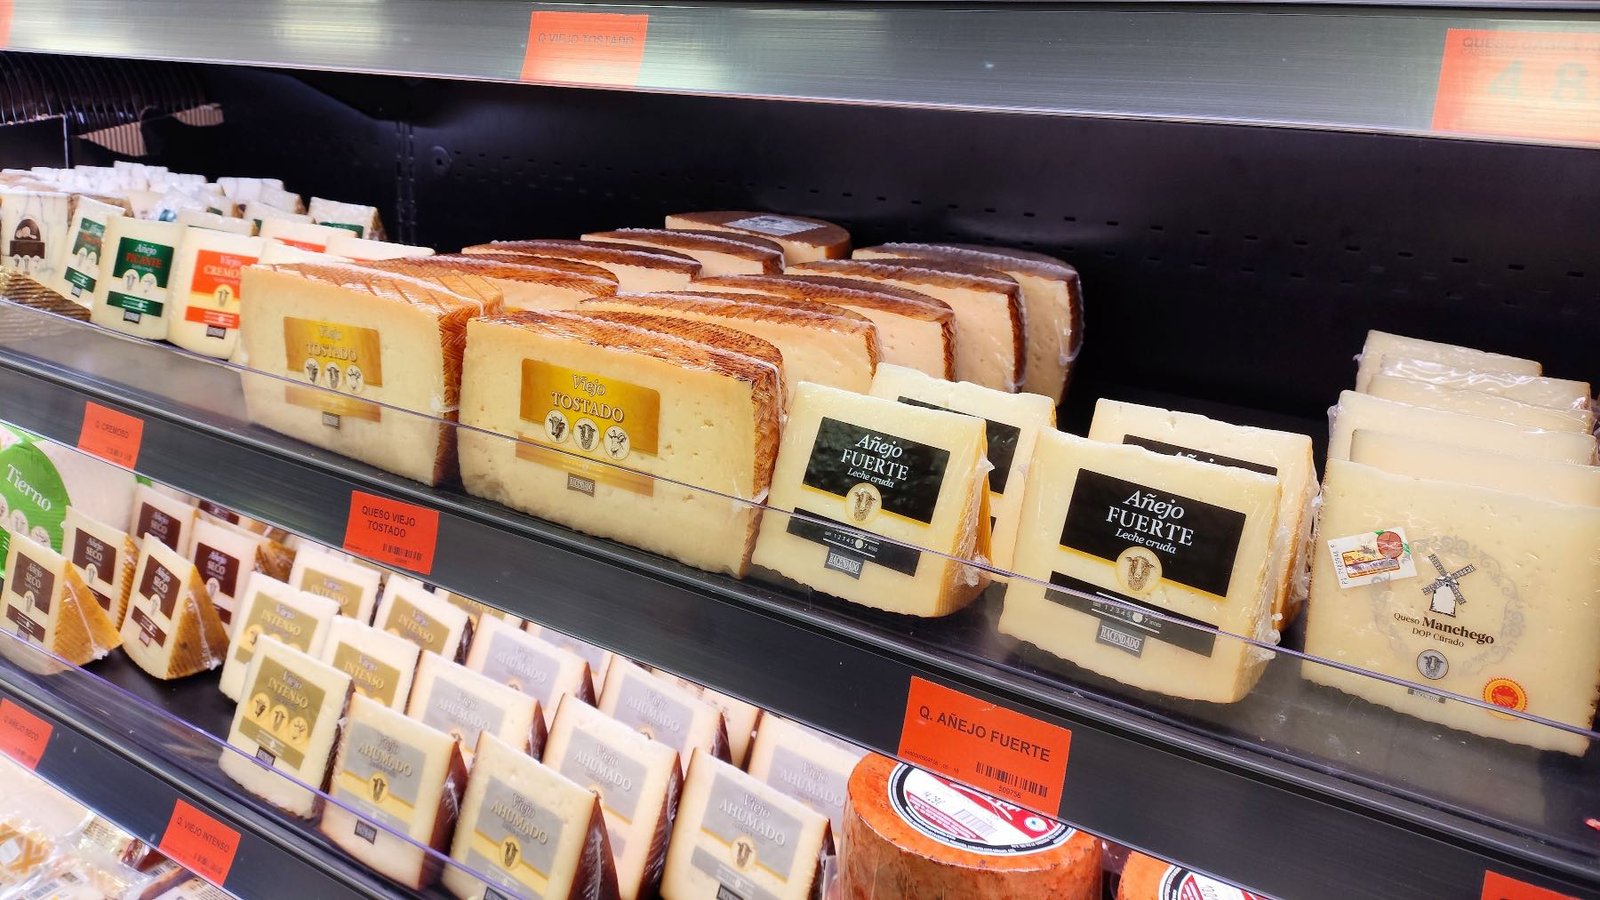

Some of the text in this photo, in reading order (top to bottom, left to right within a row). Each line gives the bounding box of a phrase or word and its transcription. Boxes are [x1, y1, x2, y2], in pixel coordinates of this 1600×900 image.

[549, 33, 579, 45] VIEJO
[572, 374, 607, 397] Viejo
[551, 391, 625, 423] TOSTADO
[854, 434, 903, 459] Añejo
[840, 449, 910, 481] FUERTE
[847, 467, 895, 489] Leche cruda
[6, 464, 52, 512] Tierno
[362, 505, 416, 527] QUESO VIEJO
[1123, 489, 1186, 520] Añejo
[367, 519, 407, 538] TOSTADO
[1105, 505, 1195, 547] FUERTE
[1115, 528, 1177, 555] Leche cruda
[1099, 625, 1142, 651] HACENDADO
[1393, 611, 1496, 646] Queso Manchego
[1411, 627, 1465, 648] DOP Curado
[267, 676, 309, 710] INTENSO
[919, 704, 1051, 762] Q. AÑEJO FUERTE
[358, 741, 414, 778] AHUMADO
[574, 751, 633, 792] AHUMADO
[780, 768, 844, 809] AHUMADO
[743, 792, 771, 819] Viejo
[184, 820, 202, 837] VIEJO
[202, 832, 231, 854] INTENSO
[490, 801, 549, 846] AHUMADO
[718, 799, 786, 847] AHUMADO
